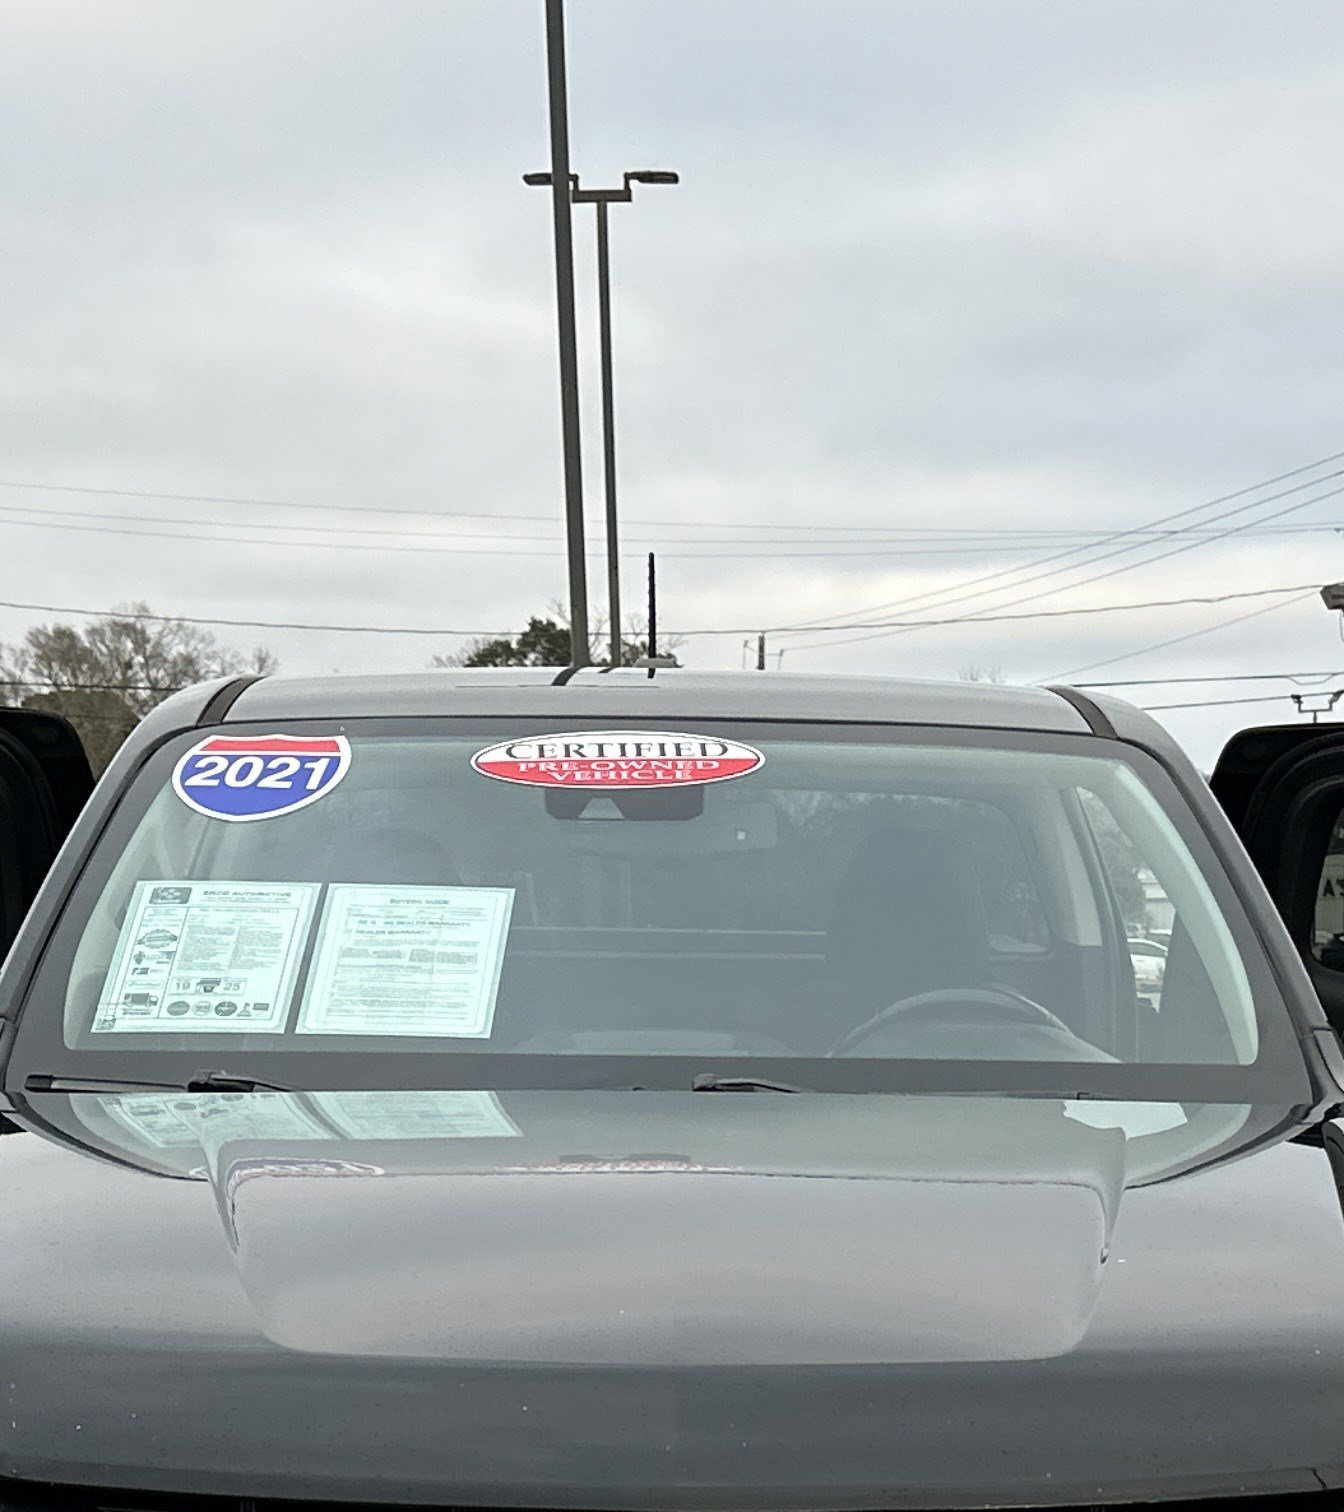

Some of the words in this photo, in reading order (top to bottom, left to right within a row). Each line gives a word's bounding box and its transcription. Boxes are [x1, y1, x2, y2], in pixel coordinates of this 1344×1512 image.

[504, 742, 730, 760] CERTIFIED
[184, 755, 330, 790] 2021
[517, 760, 721, 772] PRE-OWNED
[546, 768, 694, 782] VEHICLE
